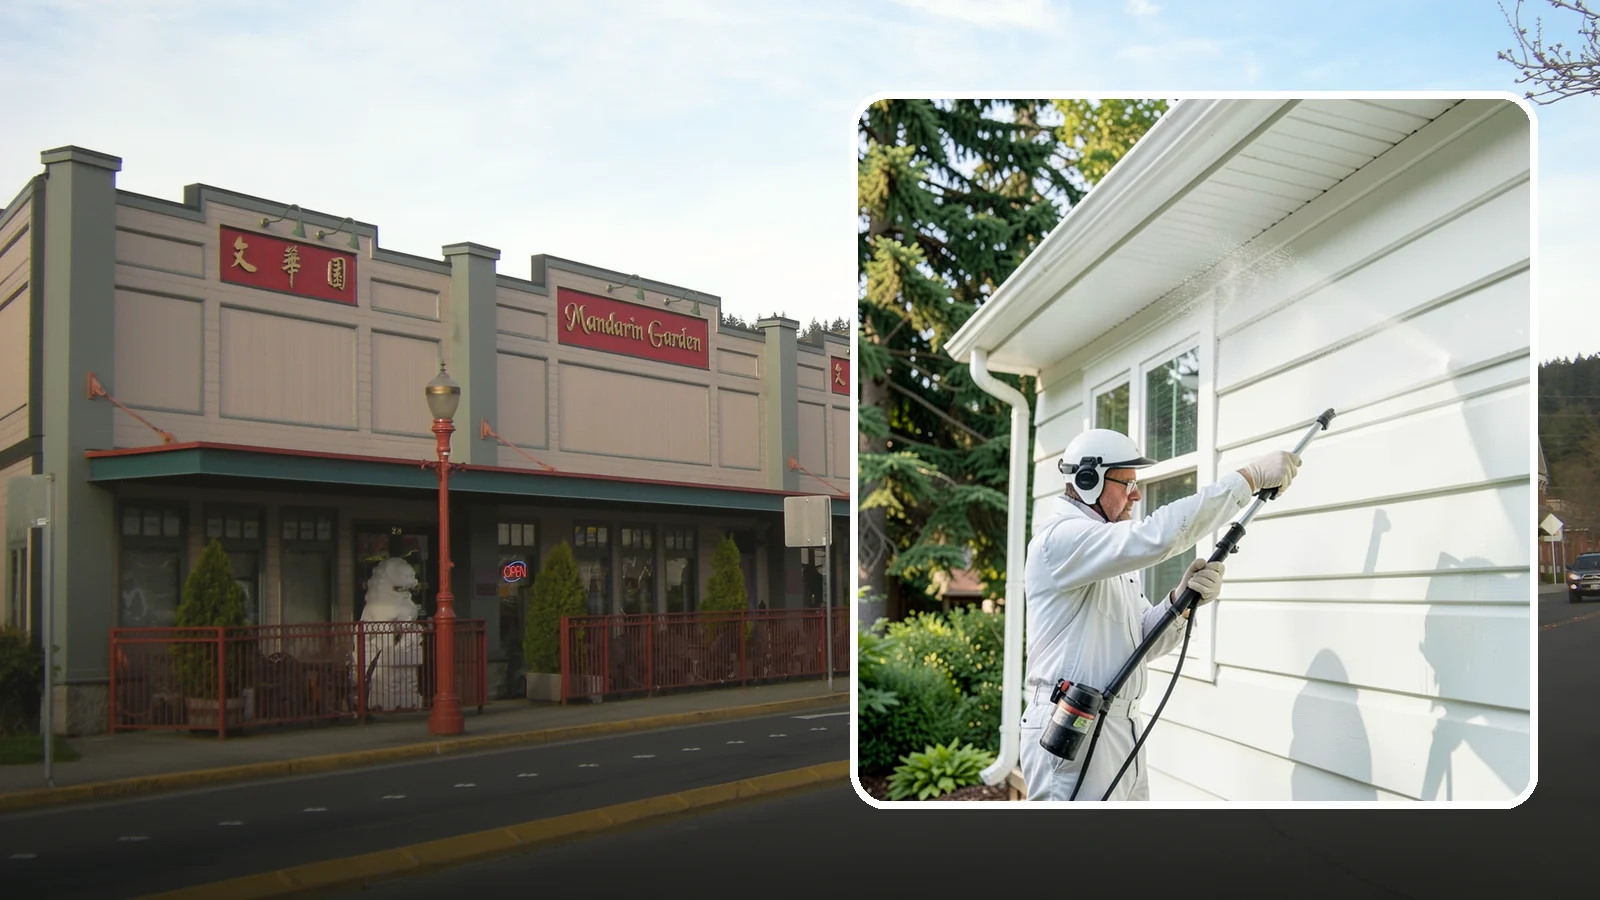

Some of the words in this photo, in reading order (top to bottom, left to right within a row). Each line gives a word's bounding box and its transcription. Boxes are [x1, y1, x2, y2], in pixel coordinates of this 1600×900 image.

[231, 236, 346, 290] 文華園
[564, 302, 644, 341] Mandarin
[648, 320, 702, 352] Garden
[834, 363, 846, 386] 文
[503, 565, 527, 578] OPEN
